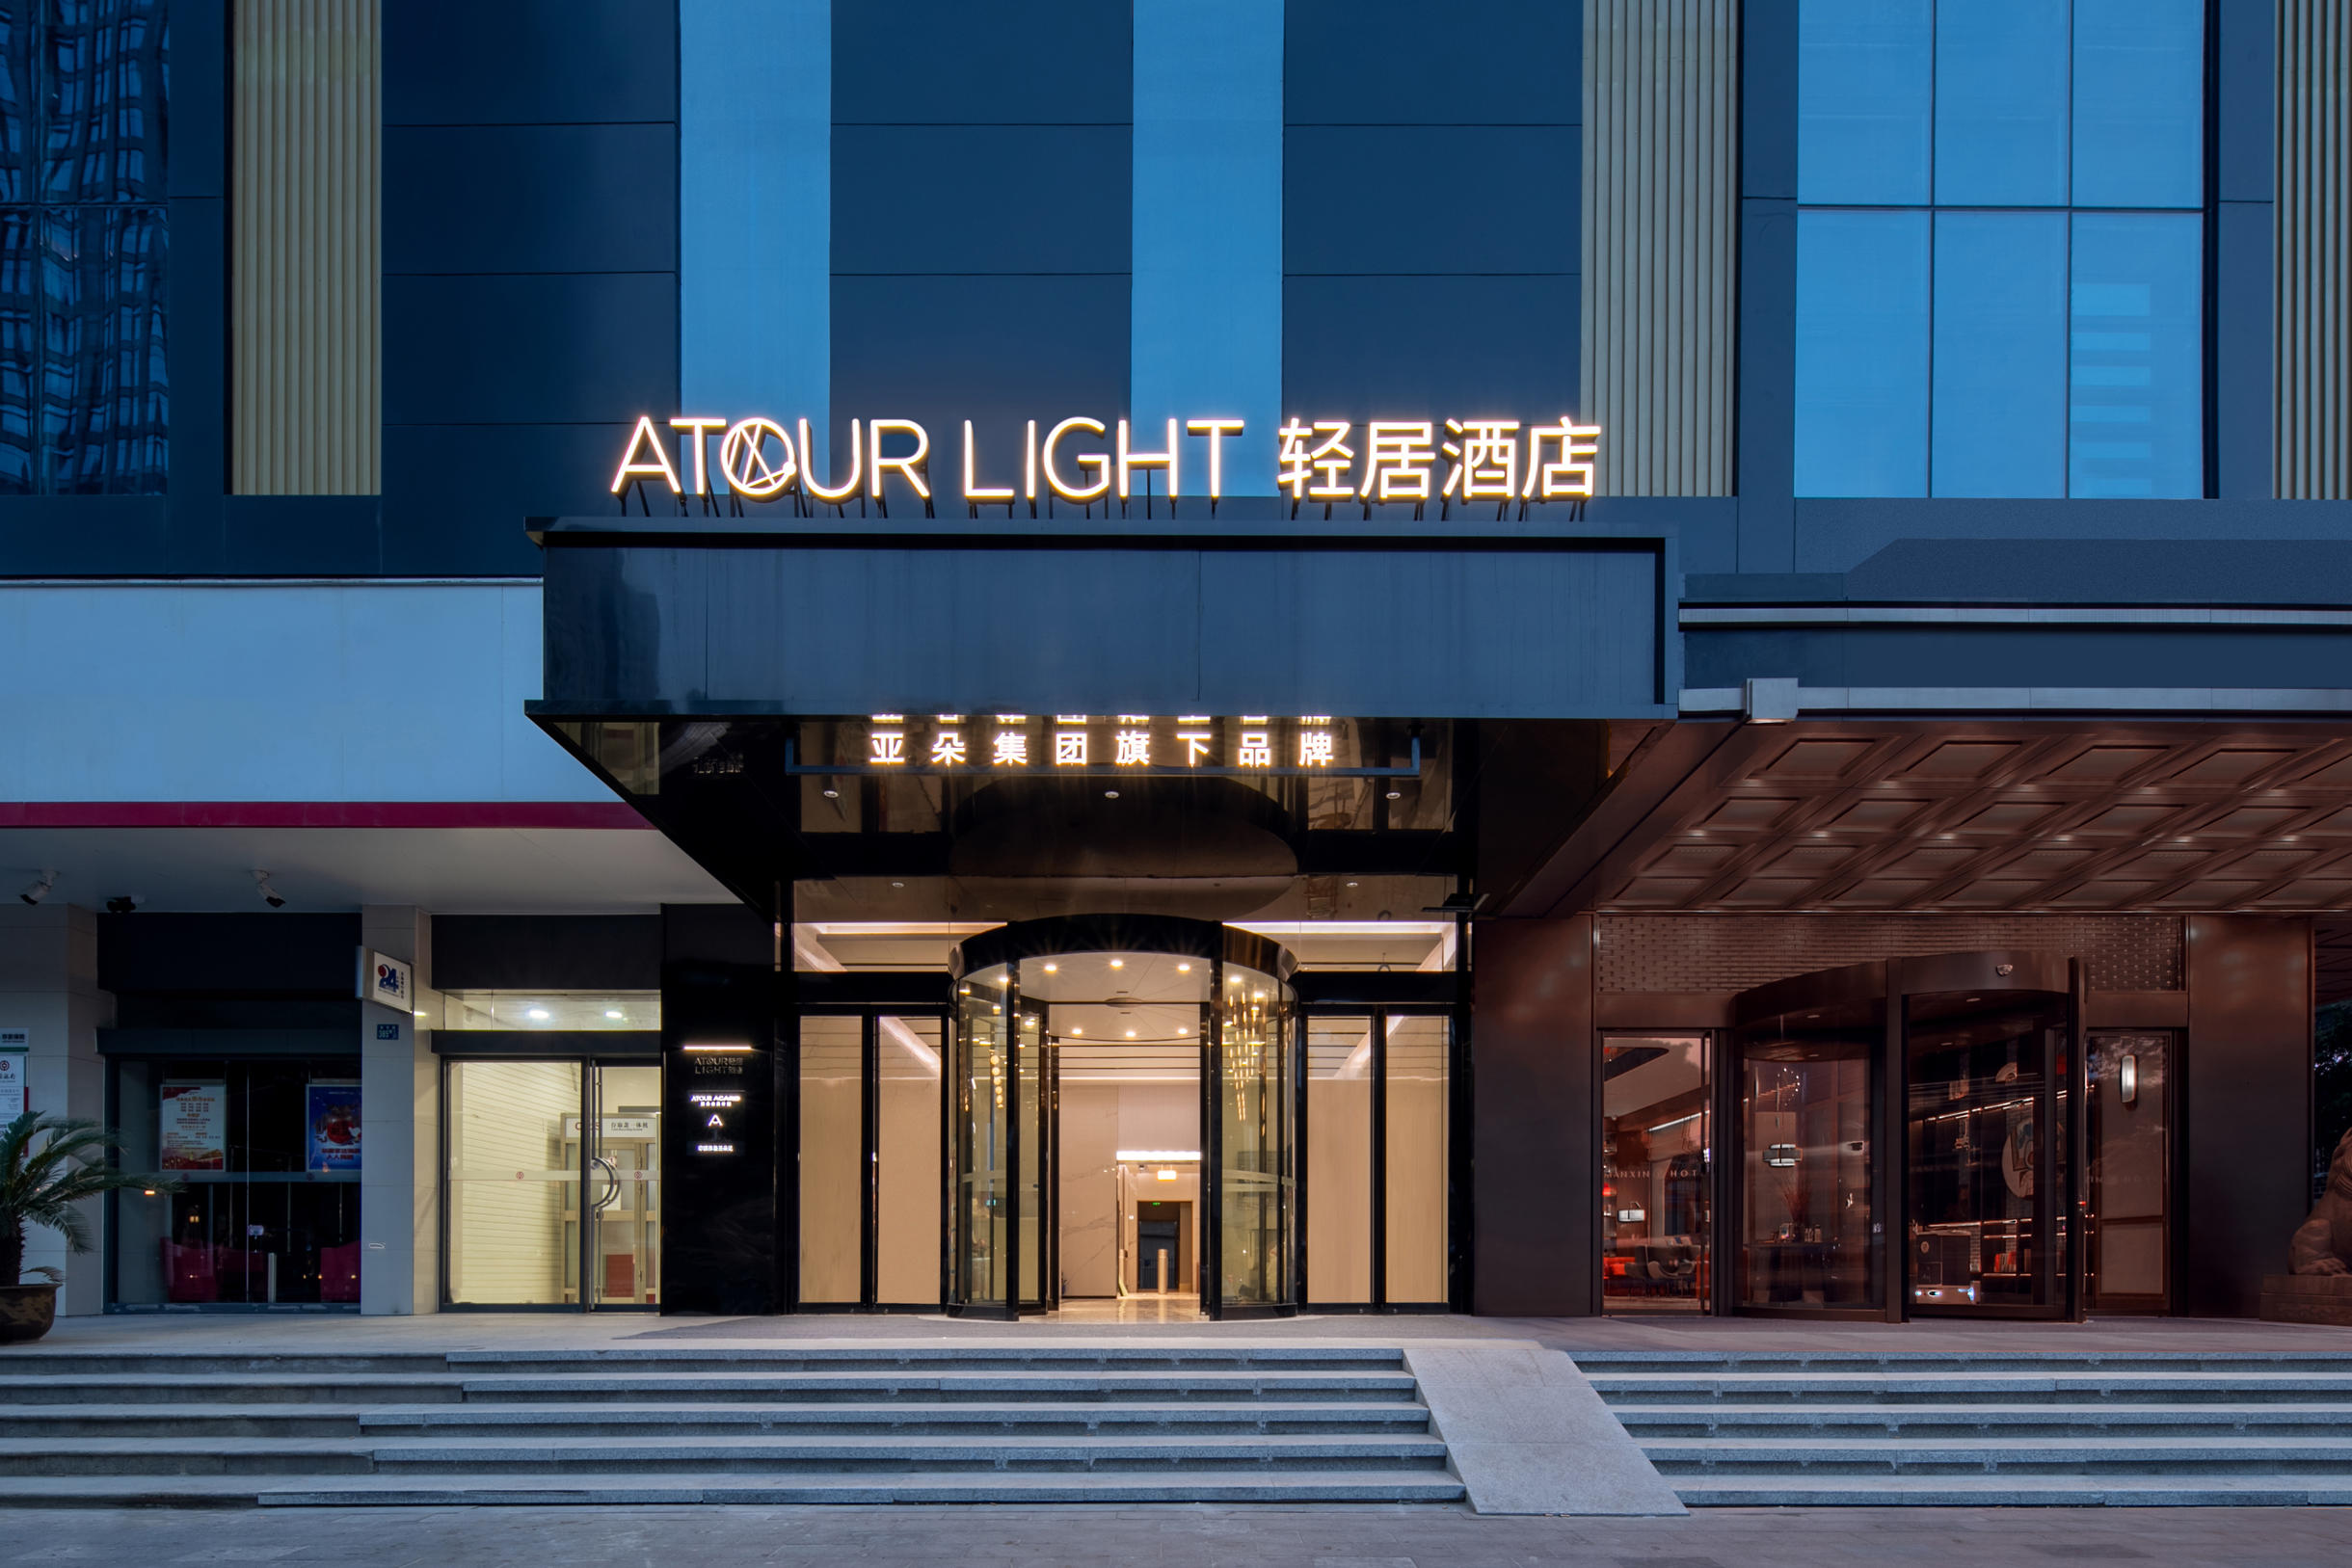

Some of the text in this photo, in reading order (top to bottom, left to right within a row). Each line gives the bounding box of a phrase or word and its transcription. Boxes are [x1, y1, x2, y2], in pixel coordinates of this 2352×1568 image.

[611, 415, 1245, 499] ATOUR LIGHT
[1277, 415, 1602, 499] 轻居酒店
[869, 731, 1335, 767] 亚朵集团旗下品牌
